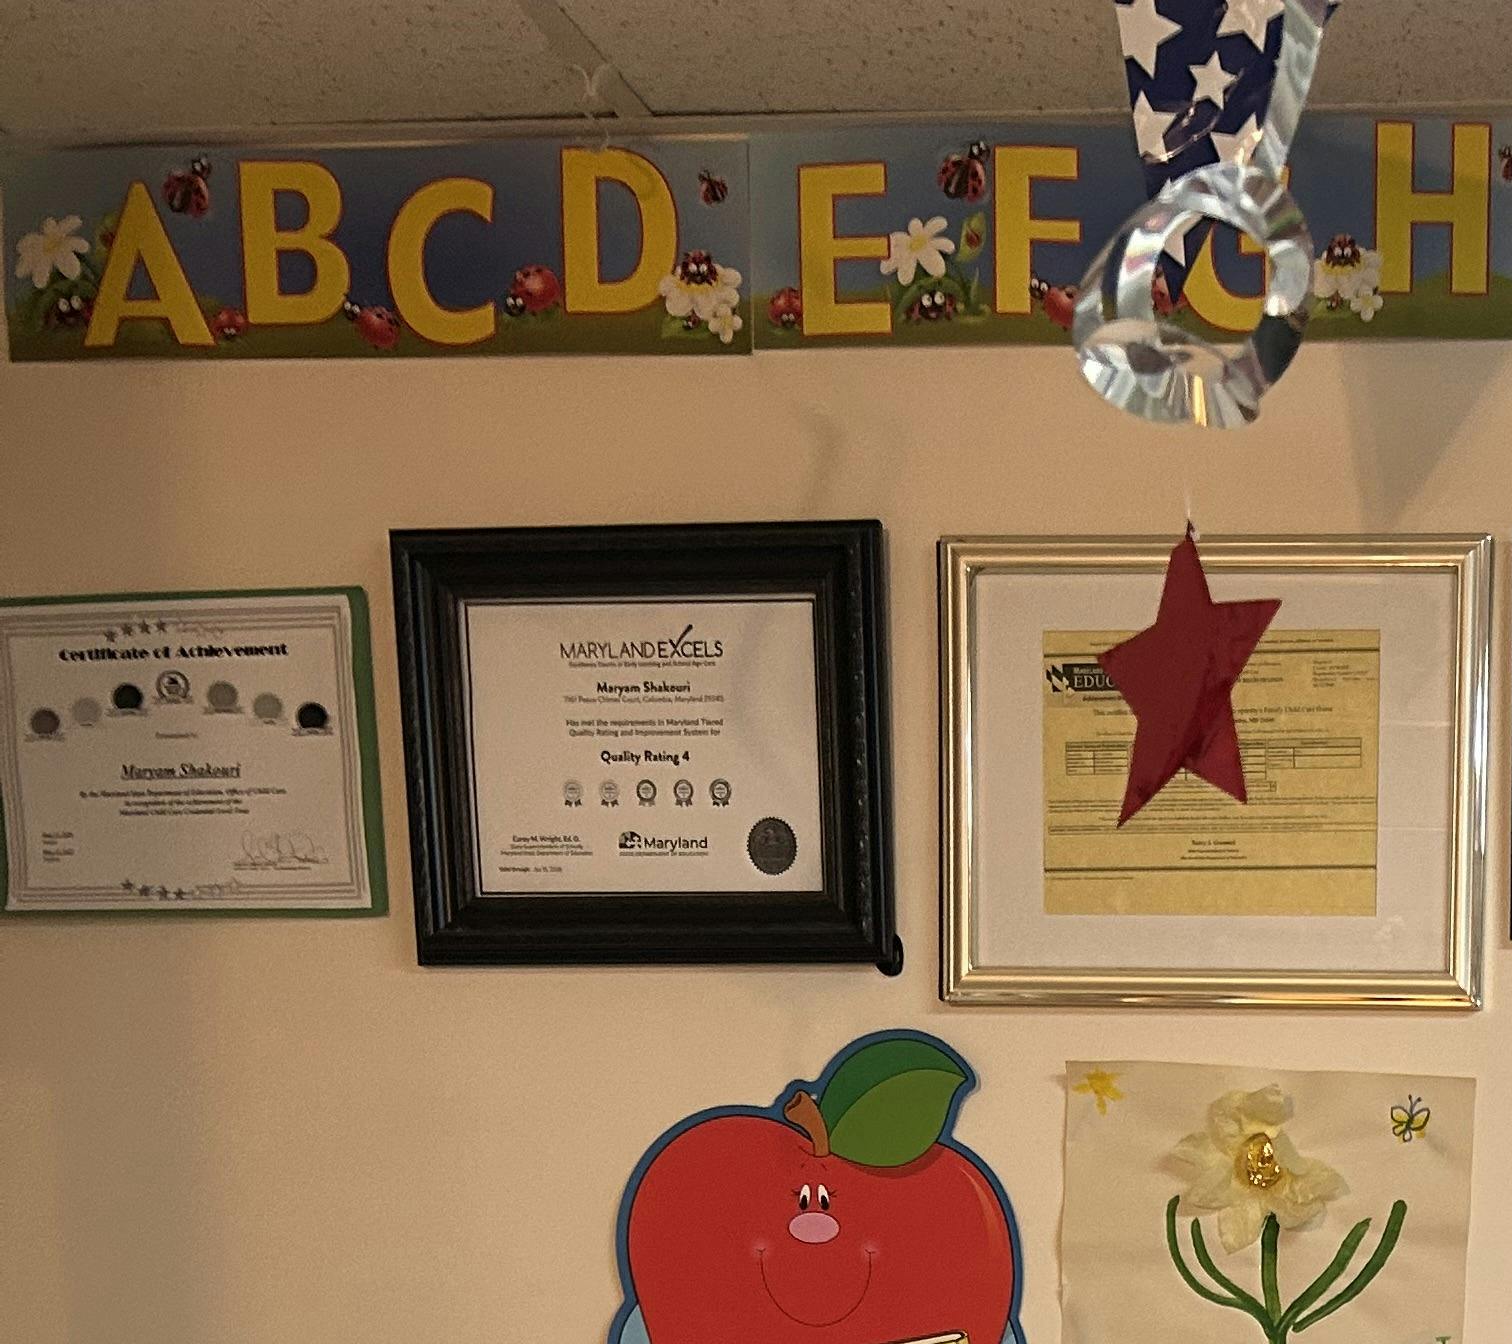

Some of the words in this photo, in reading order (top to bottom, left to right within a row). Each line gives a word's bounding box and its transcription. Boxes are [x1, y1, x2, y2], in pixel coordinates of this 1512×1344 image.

[84, 181, 214, 346] A
[237, 159, 350, 325] B
[386, 177, 496, 346] C
[560, 147, 679, 314] D
[800, 161, 893, 335] E
[995, 146, 1081, 314] F
[1375, 121, 1492, 297] H
[59, 647, 149, 661] Certificate
[153, 646, 170, 659] of
[176, 643, 289, 658] Achievement
[597, 682, 641, 697] Maryam
[643, 681, 691, 693] Shakouri
[1074, 675, 1116, 689] EDUC
[601, 751, 641, 766] Quality
[644, 751, 680, 766] Rating
[682, 751, 690, 762] 4
[644, 836, 708, 851] Maryland
